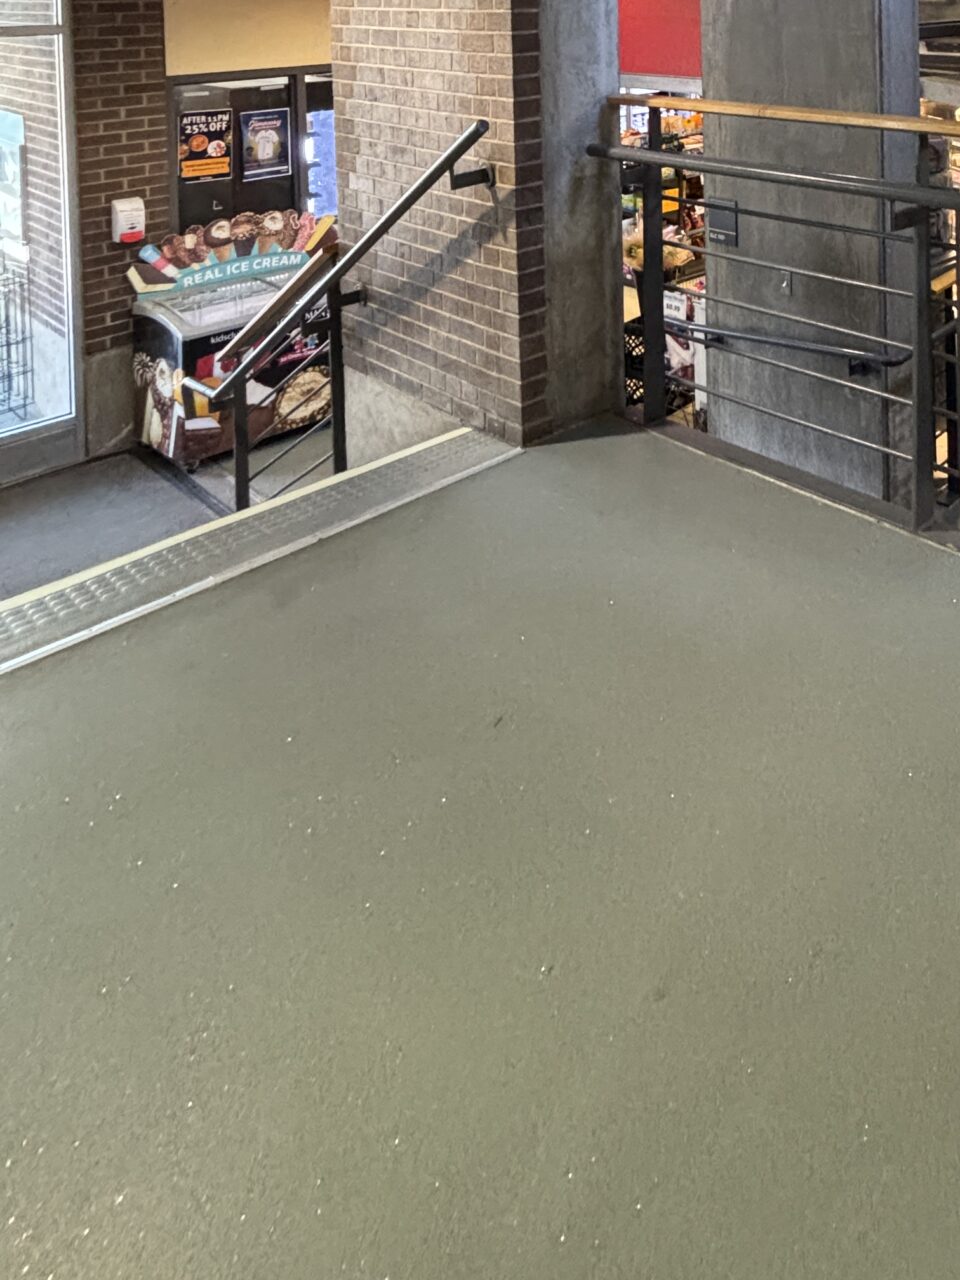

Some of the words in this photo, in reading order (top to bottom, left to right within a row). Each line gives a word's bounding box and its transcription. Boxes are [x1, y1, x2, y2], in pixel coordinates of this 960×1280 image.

[183, 115, 206, 124] AFTER
[185, 124, 208, 134] 25%
[209, 121, 228, 132] OFF
[183, 268, 224, 288] REAL
[226, 261, 250, 276] ICE
[252, 254, 302, 270] CREAM
